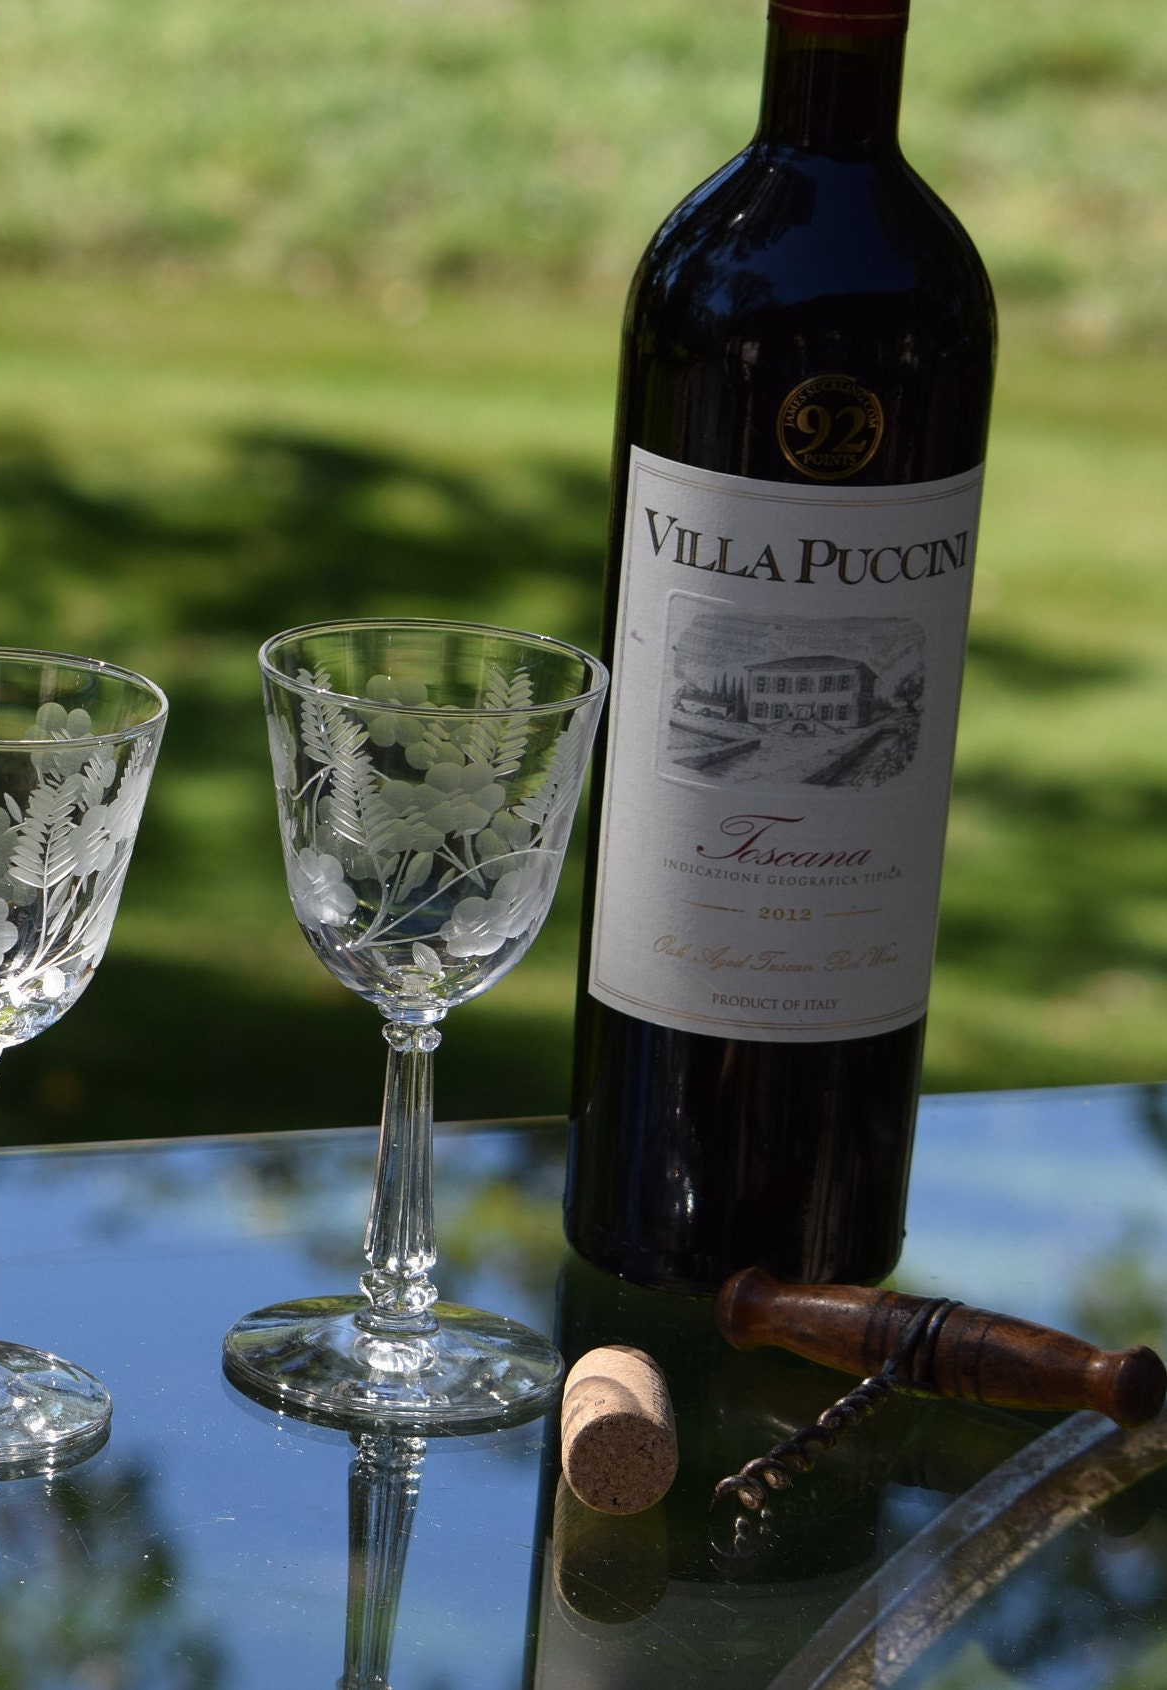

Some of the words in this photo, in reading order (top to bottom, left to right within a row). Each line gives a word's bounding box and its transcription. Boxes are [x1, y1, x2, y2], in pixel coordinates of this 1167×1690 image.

[795, 404, 867, 455] 92
[803, 453, 858, 466] POINTS
[644, 507, 786, 583] VILLA
[794, 530, 969, 585] PUCCINI
[696, 814, 872, 868] Toscana
[663, 857, 761, 885] INDICAZIONE
[767, 873, 859, 888] GEOGRAFICA
[758, 906, 813, 922] 2012
[694, 945, 753, 972] Aged
[750, 950, 815, 972] Tuscan
[824, 949, 867, 972] Red
[712, 992, 780, 1011] PRODUCT
[782, 998, 801, 1011] OF
[804, 998, 840, 1011] ITALY
